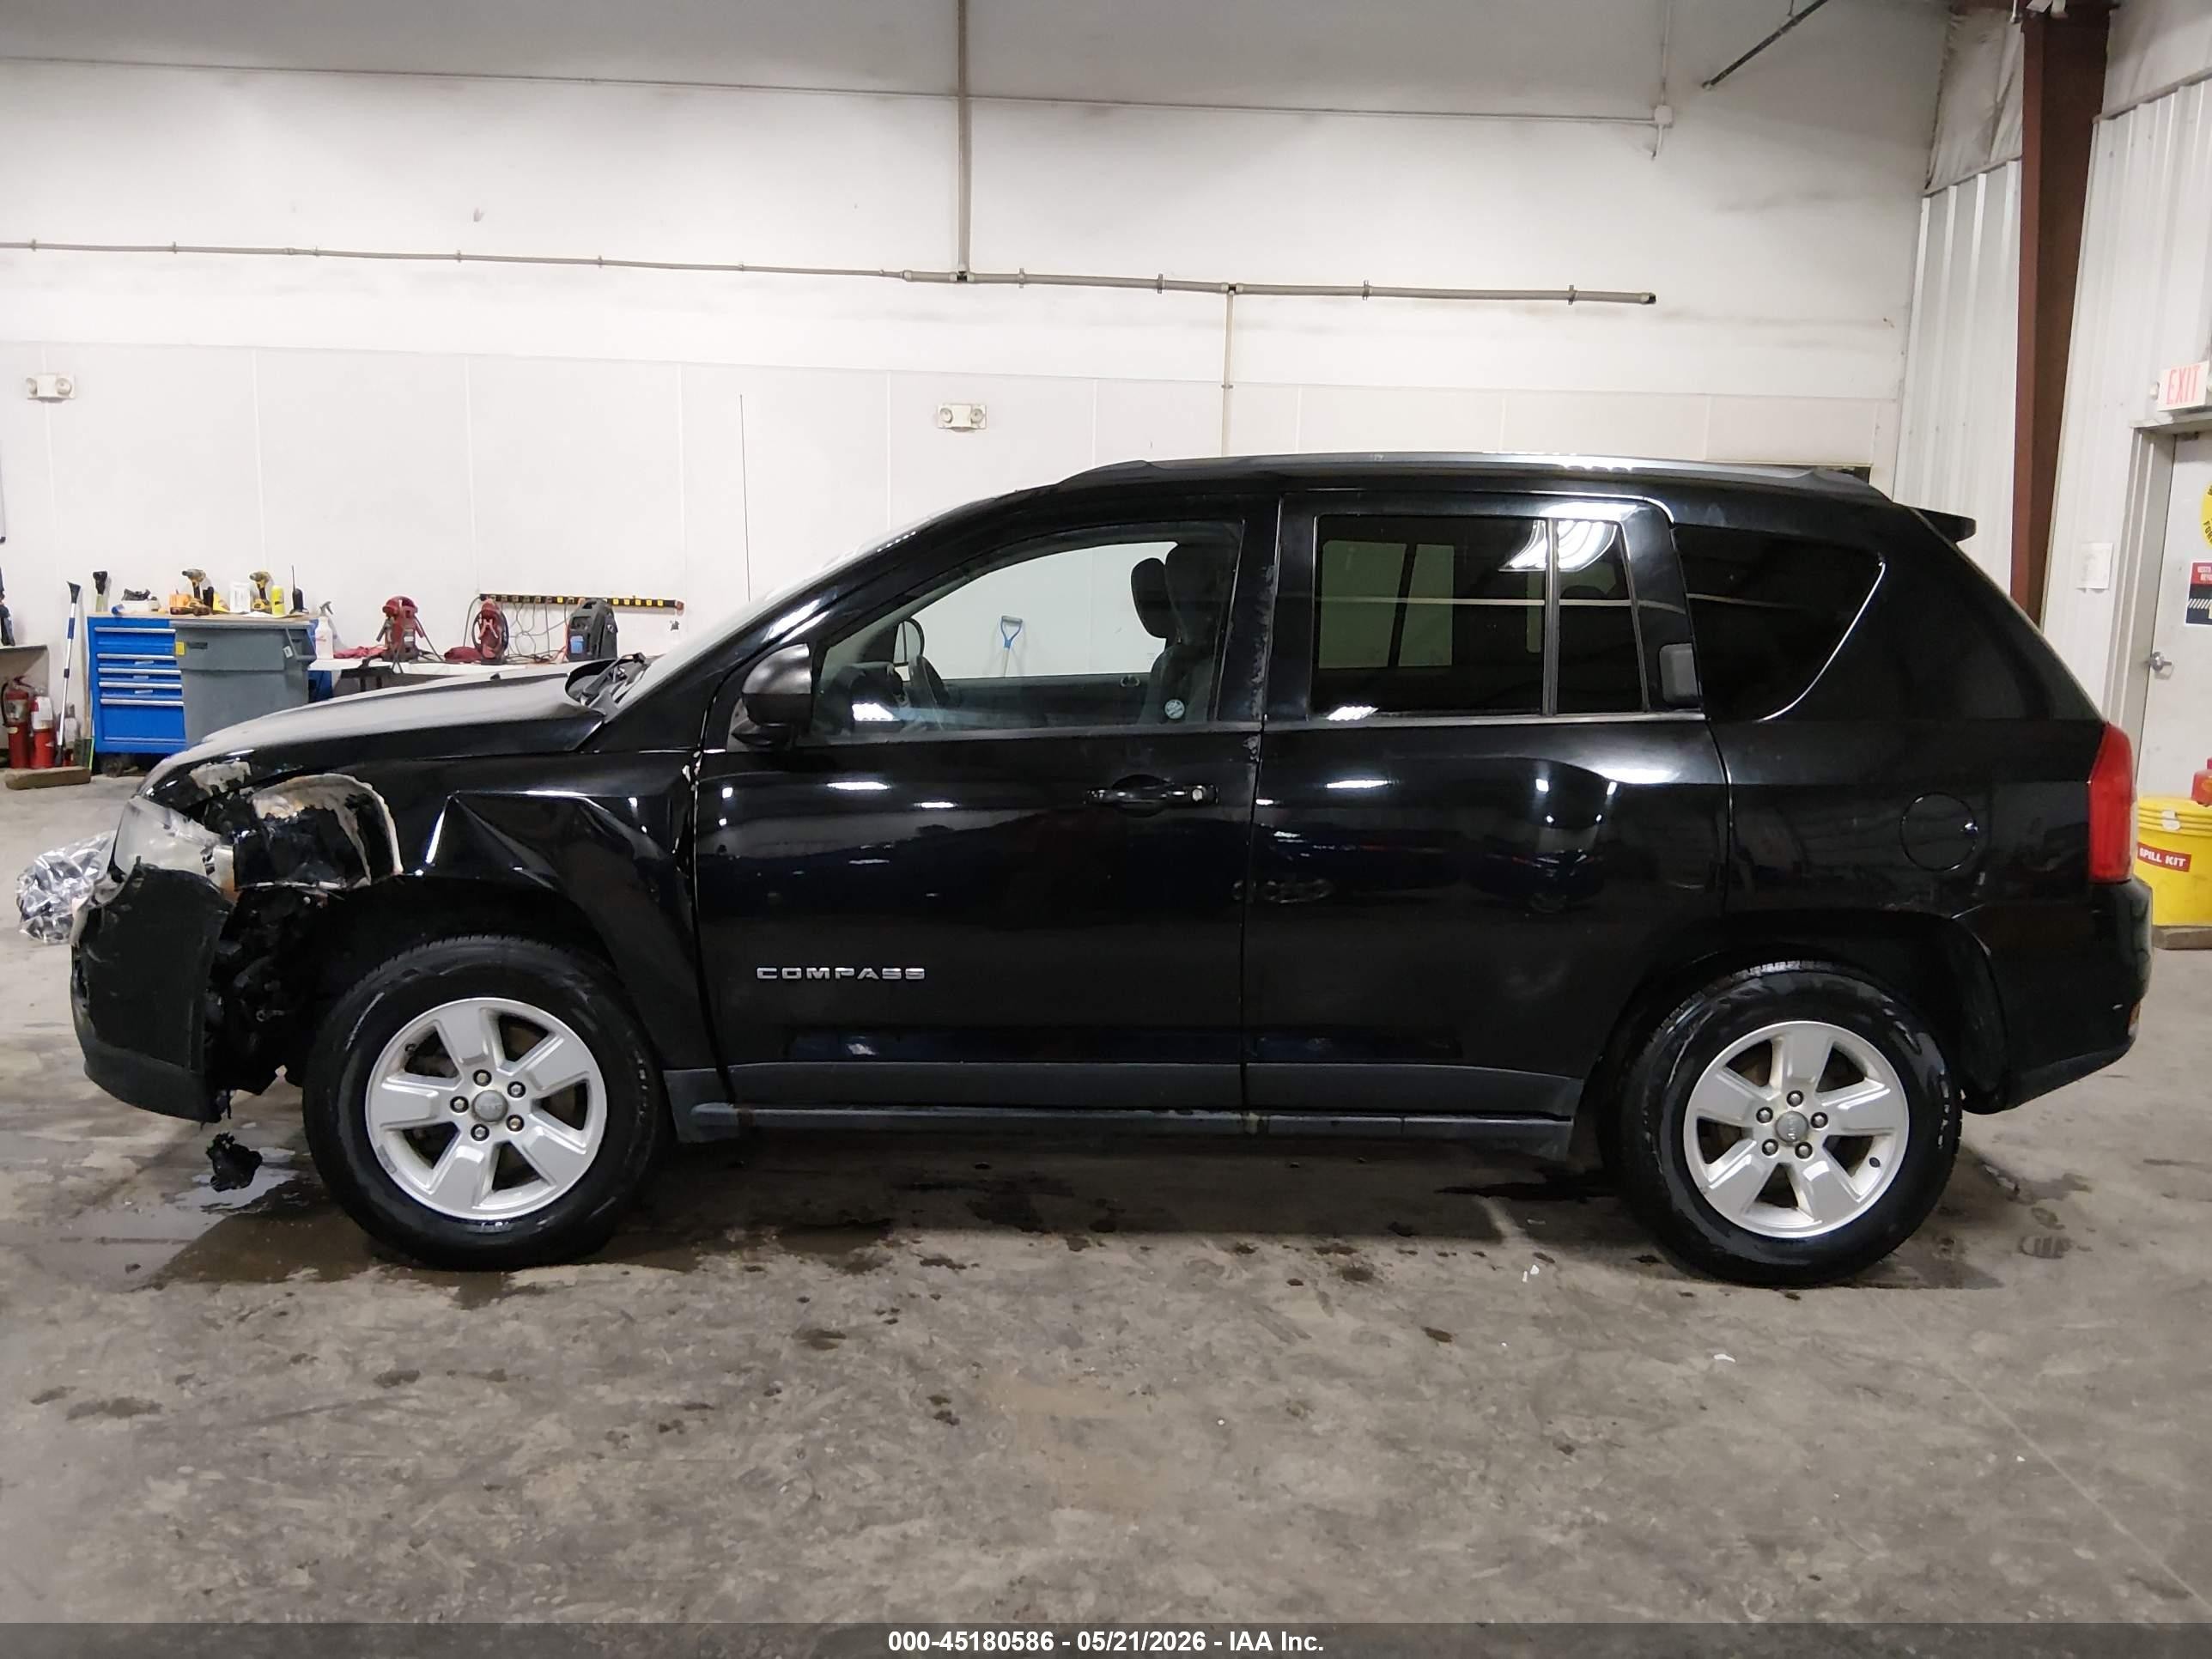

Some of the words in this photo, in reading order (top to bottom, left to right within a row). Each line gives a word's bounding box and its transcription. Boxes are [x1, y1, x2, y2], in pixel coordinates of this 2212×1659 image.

[2166, 365, 2199, 404] EXIT
[2139, 848, 2162, 863] SPILL
[2165, 855, 2186, 867] KIT
[757, 967, 925, 980] COMPASS
